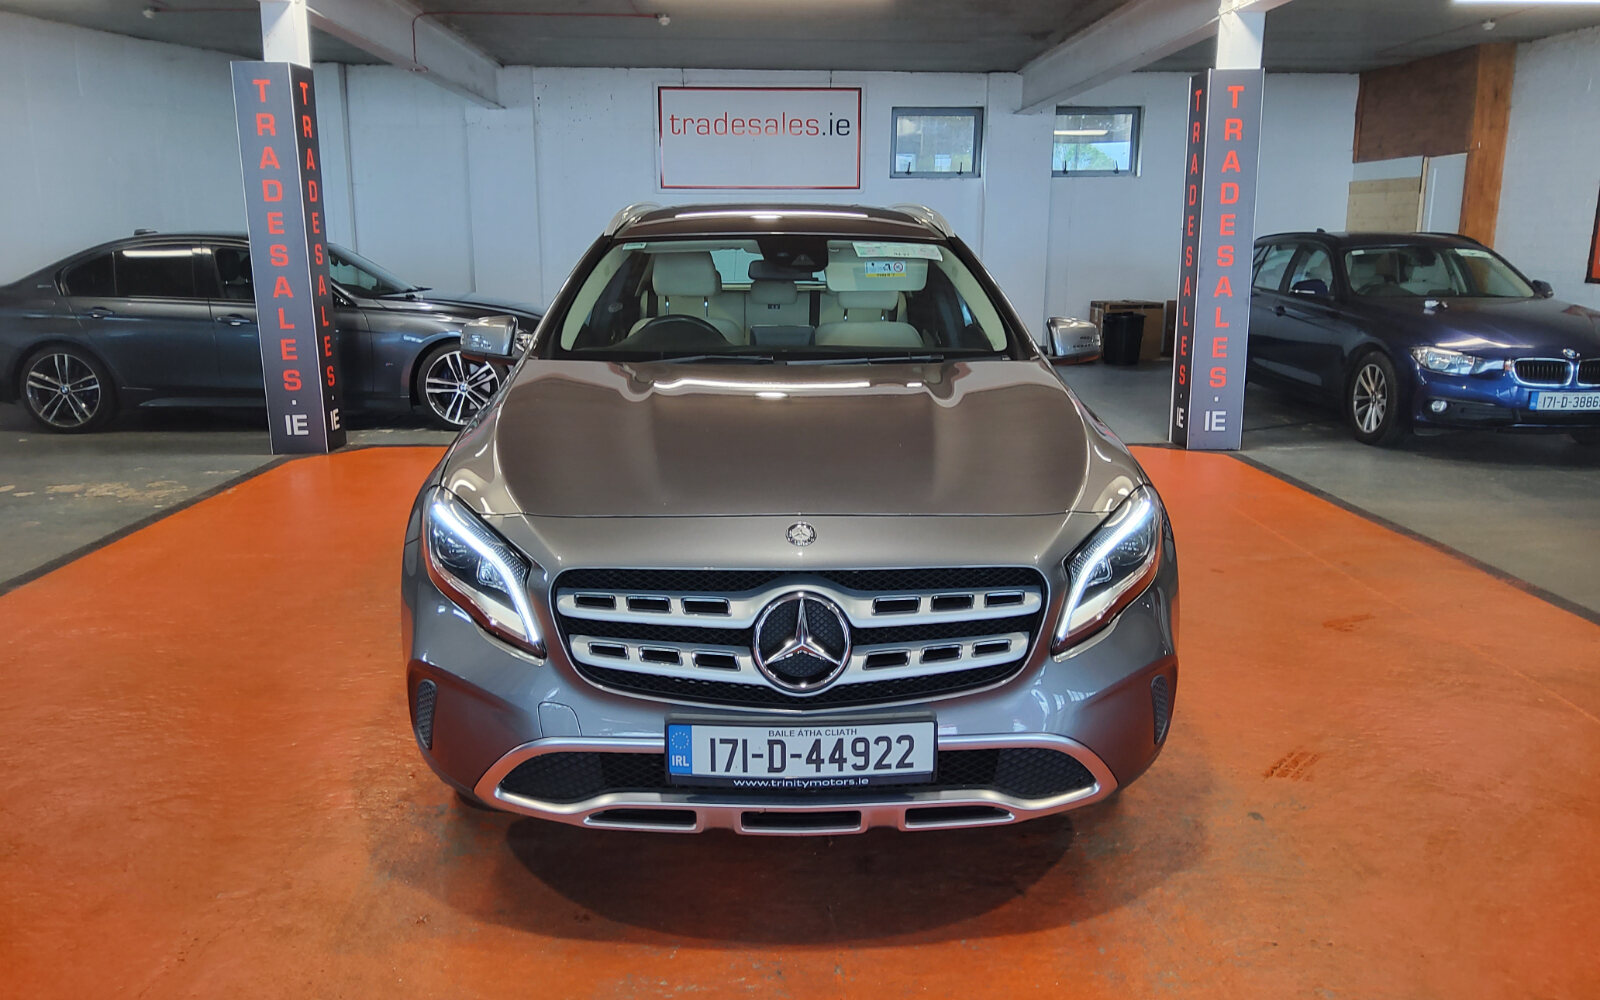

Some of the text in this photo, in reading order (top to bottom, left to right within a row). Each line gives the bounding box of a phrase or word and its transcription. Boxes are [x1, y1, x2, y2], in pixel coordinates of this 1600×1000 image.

[669, 111, 850, 136] tradesales.ie
[1542, 396, 1600, 408] 171-D-3886
[768, 729, 795, 737] BAILE
[824, 728, 857, 736] CLIATH
[709, 734, 915, 773] 171-D-44922
[671, 754, 690, 767] IRL
[733, 778, 869, 788] www.trinitymotors.ie
